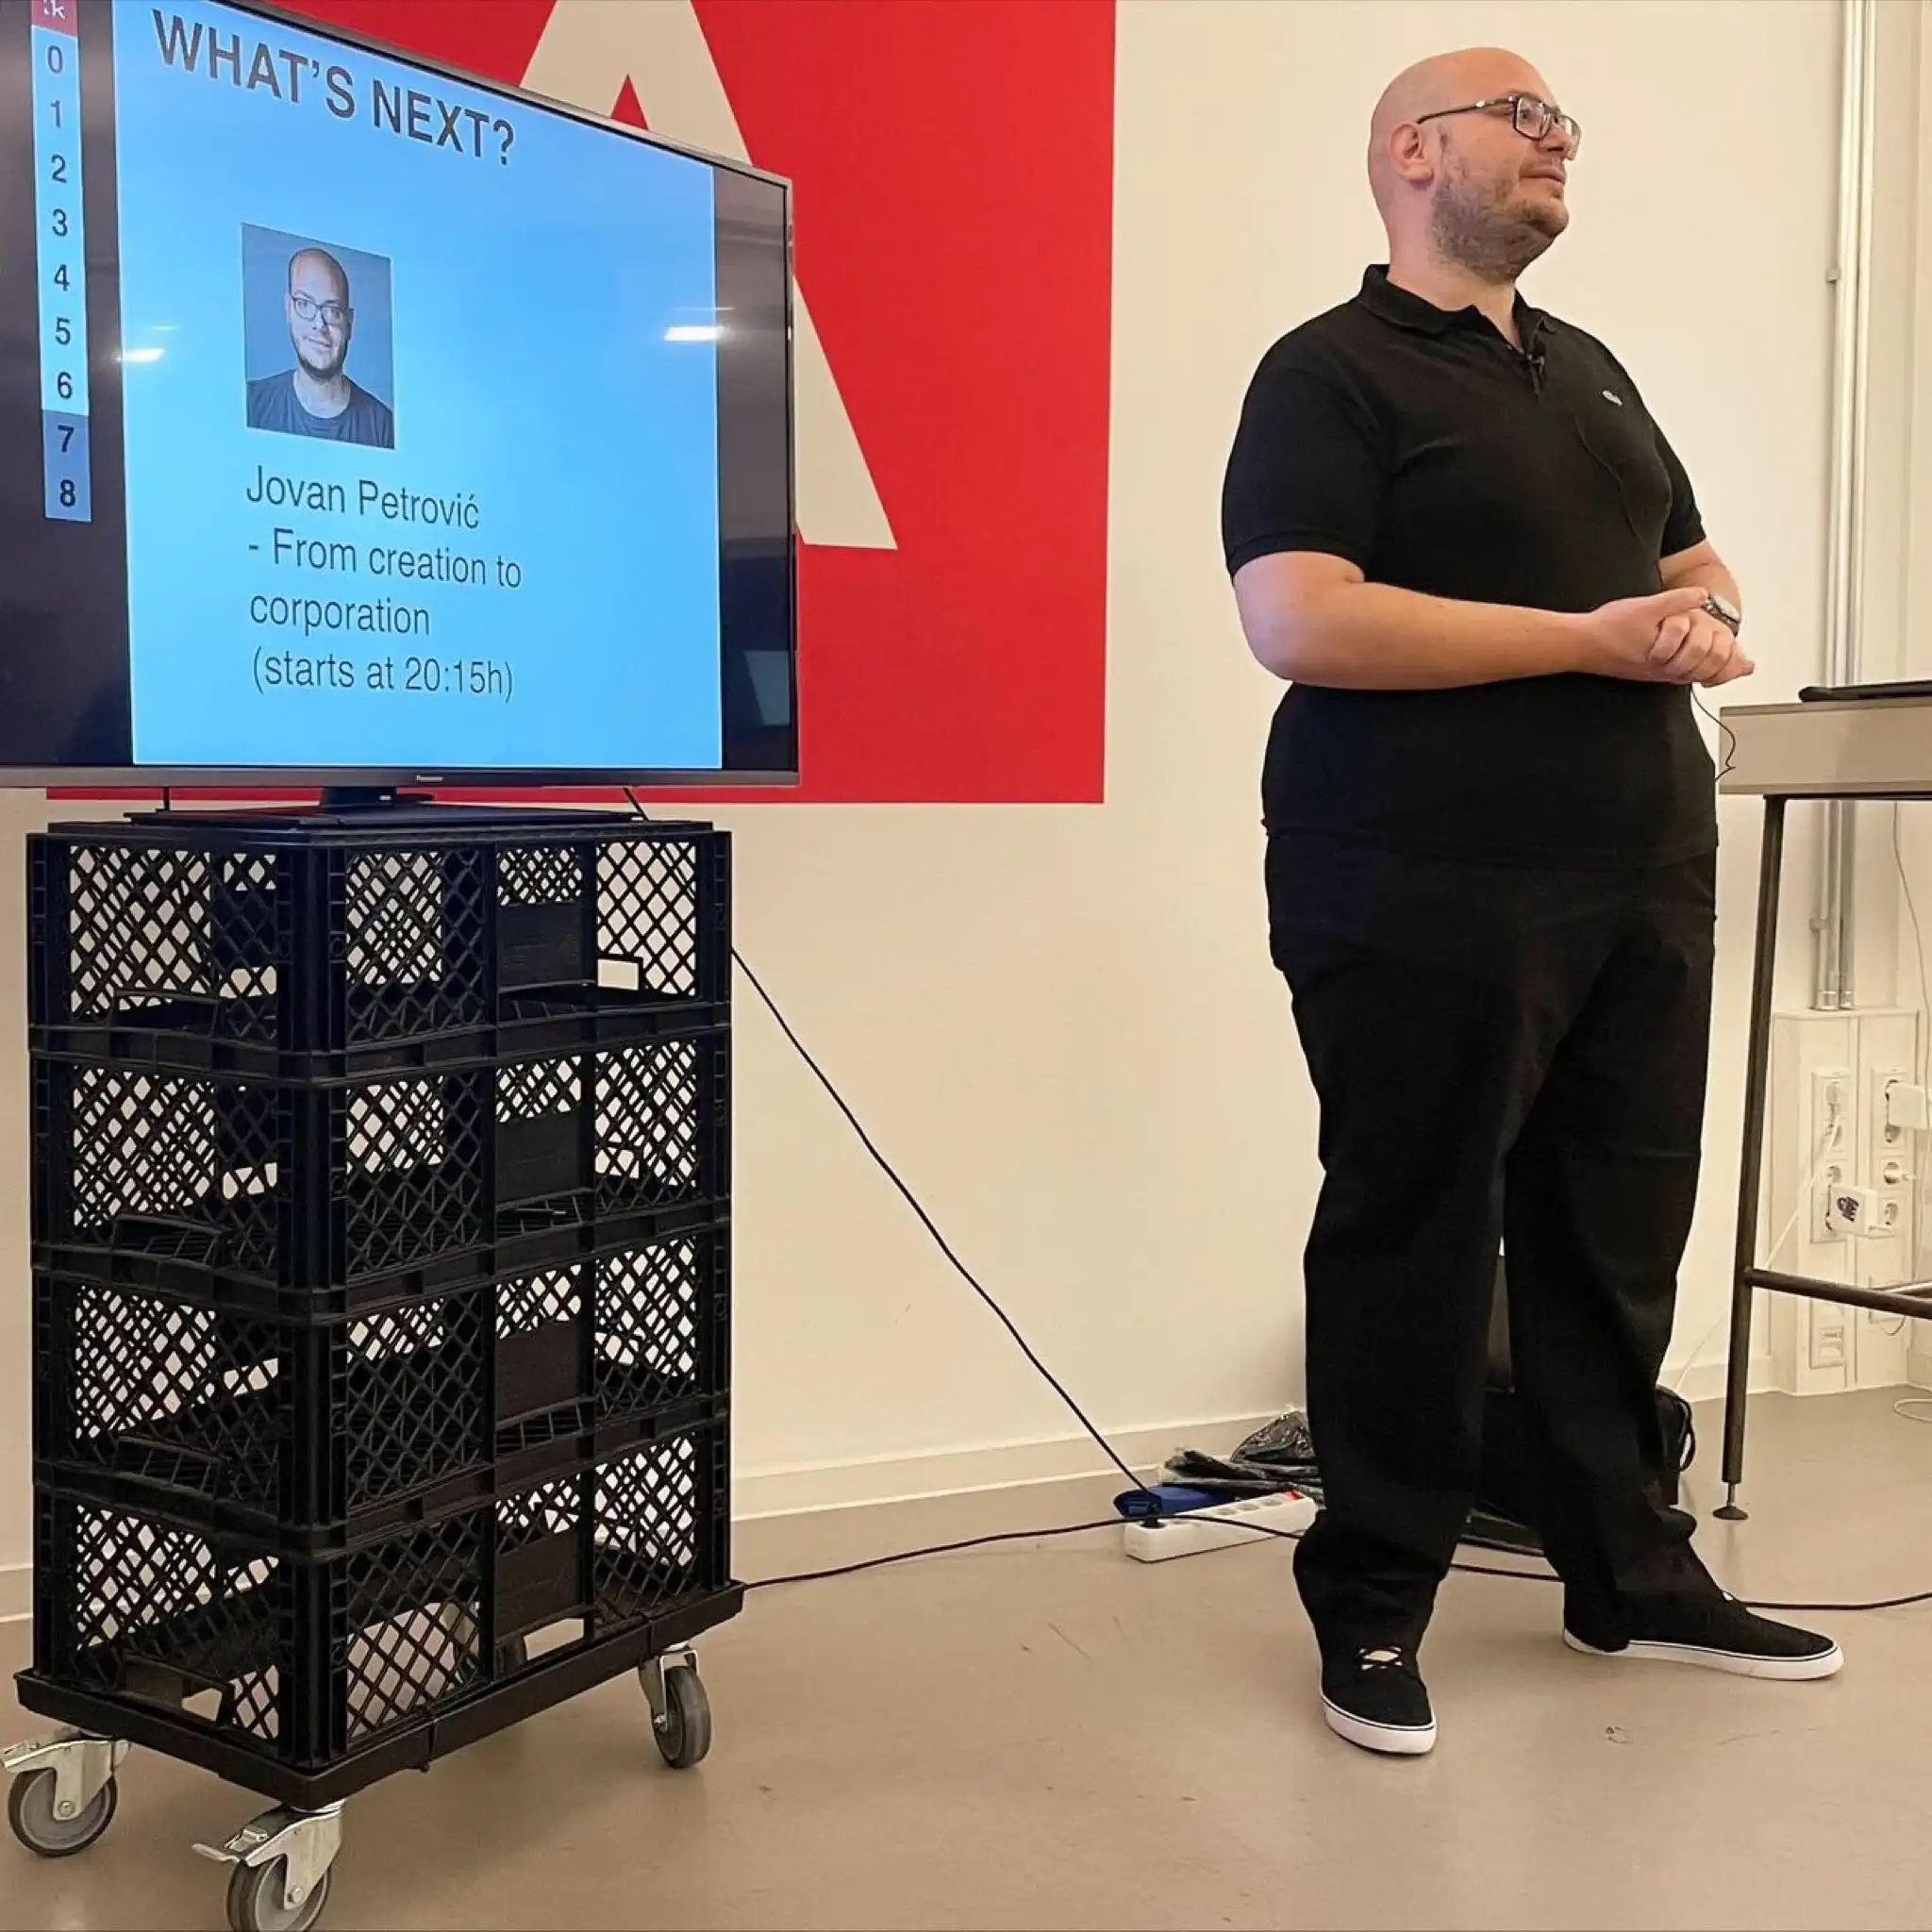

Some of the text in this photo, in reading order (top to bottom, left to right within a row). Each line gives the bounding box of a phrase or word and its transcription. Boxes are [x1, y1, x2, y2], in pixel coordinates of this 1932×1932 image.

[47, 44, 63, 74] 0
[50, 100, 61, 128] 1
[373, 79, 514, 165] NEXT?
[51, 154, 68, 184] 2
[52, 208, 69, 238] 3
[53, 263, 70, 292] 4
[54, 316, 72, 346] 5
[57, 370, 74, 400] 6
[57, 425, 75, 454] 7
[58, 479, 76, 508] 8
[245, 464, 479, 529] Jovan Petrović
[273, 527, 358, 573] From
[369, 546, 488, 583] creation
[495, 555, 522, 589] to
[250, 595, 430, 636] corporation
[252, 645, 513, 704] (starts at 20:15h)
